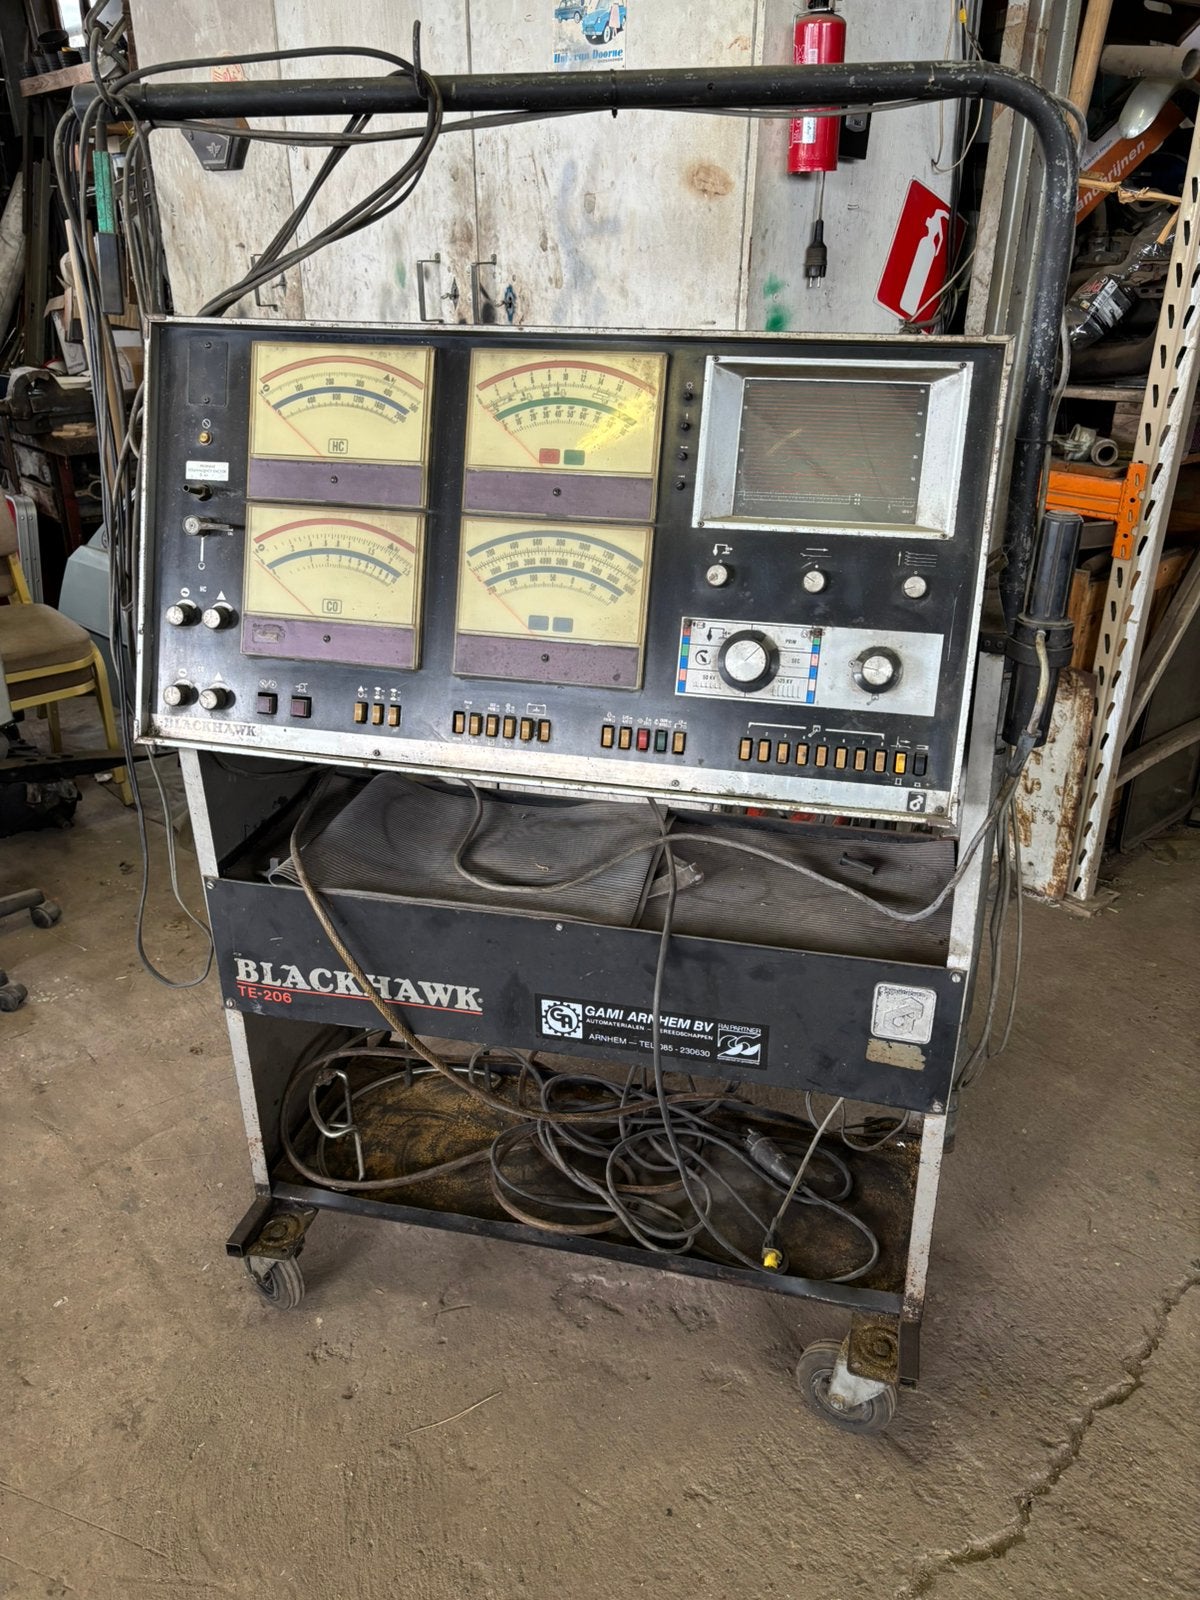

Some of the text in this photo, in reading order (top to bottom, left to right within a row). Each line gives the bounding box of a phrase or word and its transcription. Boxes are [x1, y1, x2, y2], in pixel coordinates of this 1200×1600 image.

[592, 49, 623, 59] Doorne
[356, 379, 365, 388] 300
[384, 388, 393, 398] 400
[353, 395, 364, 404] 1200
[332, 441, 344, 452] HC
[486, 548, 495, 558] 200
[556, 538, 566, 546] 800
[578, 542, 591, 552] 1000
[602, 550, 614, 560] 1200
[507, 560, 519, 570] 2000
[524, 558, 536, 566] 3000
[556, 558, 568, 566] 5000
[572, 560, 586, 570] 6000
[590, 566, 603, 576] 7000
[607, 574, 620, 584] 8000
[530, 574, 538, 582] 100
[550, 574, 556, 582] 50
[590, 583, 597, 592] 50
[326, 602, 338, 612] CO
[234, 958, 483, 1012] BLACKHAWK
[237, 985, 292, 1004] TE-206
[584, 1006, 624, 1020] GAMI
[693, 1020, 714, 1032] BV
[586, 1018, 645, 1031] AUTOMATERIALEN
[659, 1029, 714, 1041] EREEDSCHAPPEN
[589, 1034, 627, 1045] ARNHEM
[680, 1046, 710, 1058] 230630
